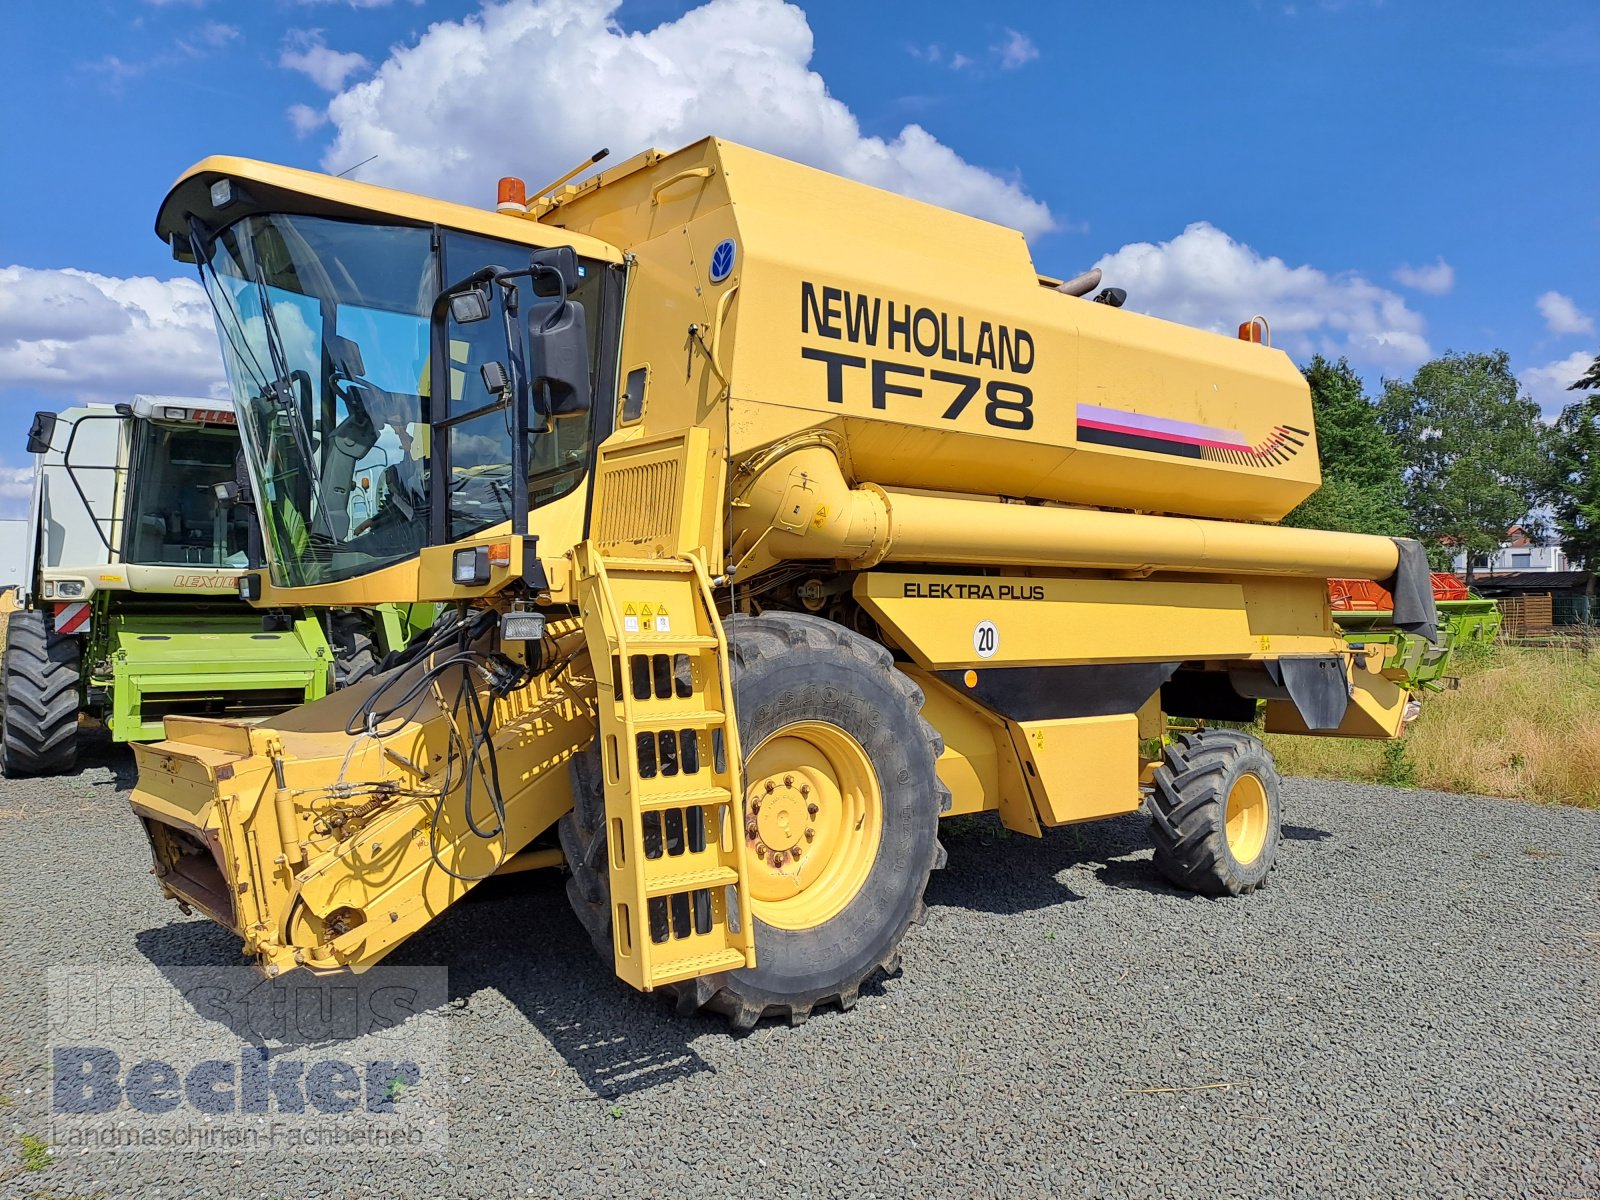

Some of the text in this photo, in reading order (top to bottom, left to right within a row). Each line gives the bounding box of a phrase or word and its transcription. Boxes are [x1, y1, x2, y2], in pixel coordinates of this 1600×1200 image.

[802, 280, 1035, 375] NEW HOLLAND
[801, 346, 1034, 431] TF78
[191, 408, 236, 423] CLA
[903, 582, 1045, 600] ELEKTRA PLUS
[978, 627, 994, 652] 20
